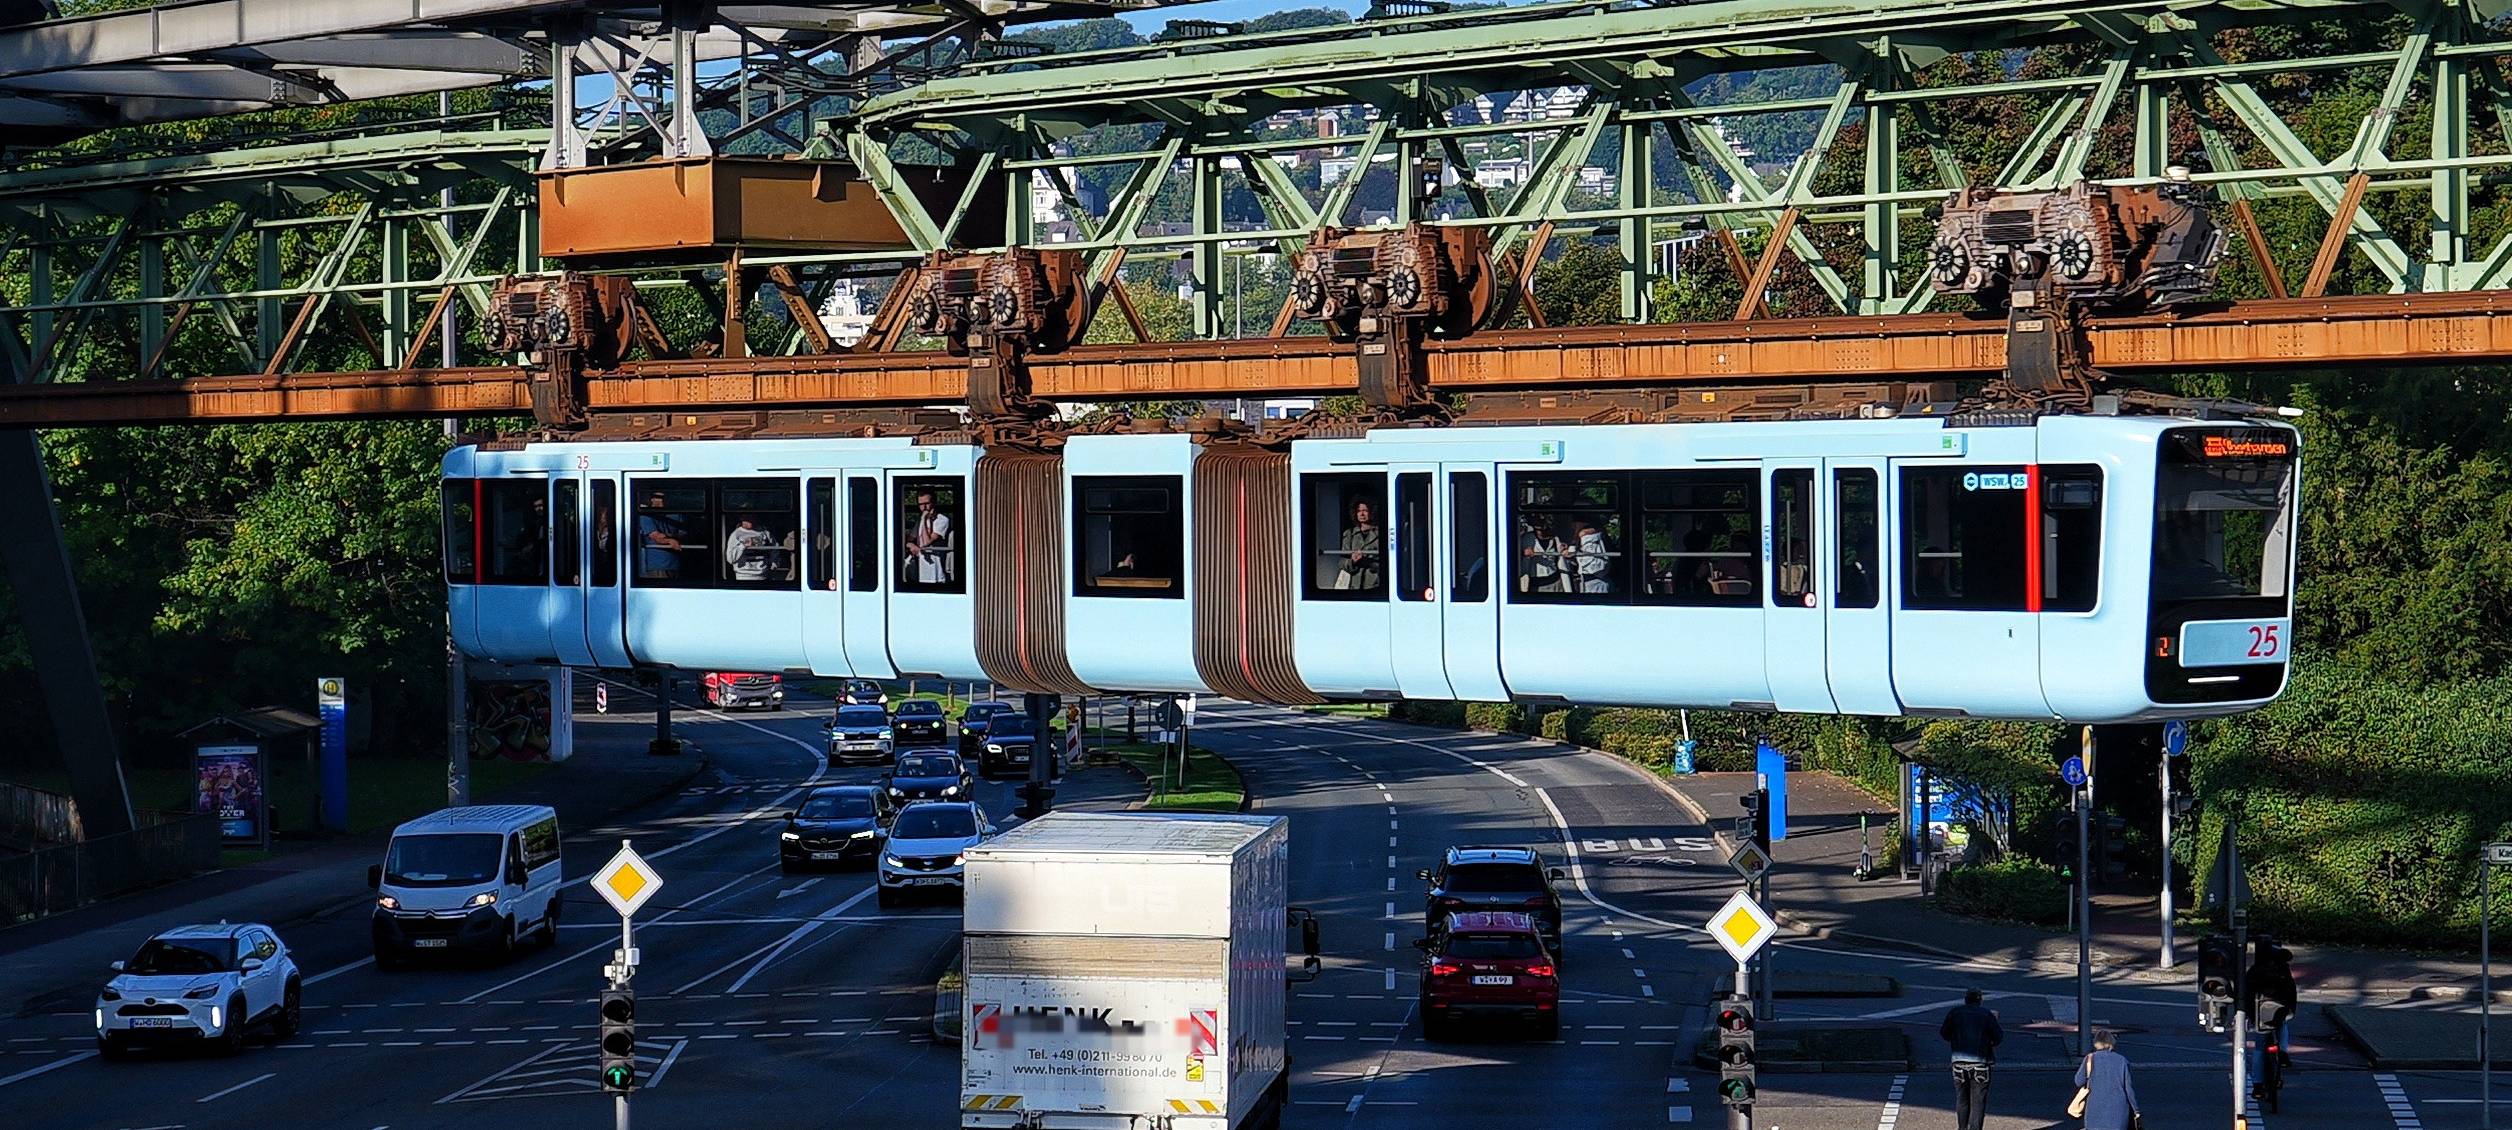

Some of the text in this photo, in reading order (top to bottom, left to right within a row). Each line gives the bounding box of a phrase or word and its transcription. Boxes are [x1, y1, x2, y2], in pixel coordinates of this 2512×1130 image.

[577, 455, 589, 469] 25
[2013, 476, 2025, 487] 25
[2158, 636, 2170, 657] 2
[2247, 625, 2279, 657] 25
[1582, 837, 1715, 852] BUS
[1028, 1048, 1048, 1060] Tel.
[1052, 1049, 1074, 1061] +49
[1013, 1064, 1177, 1078] www.henk-international.de
